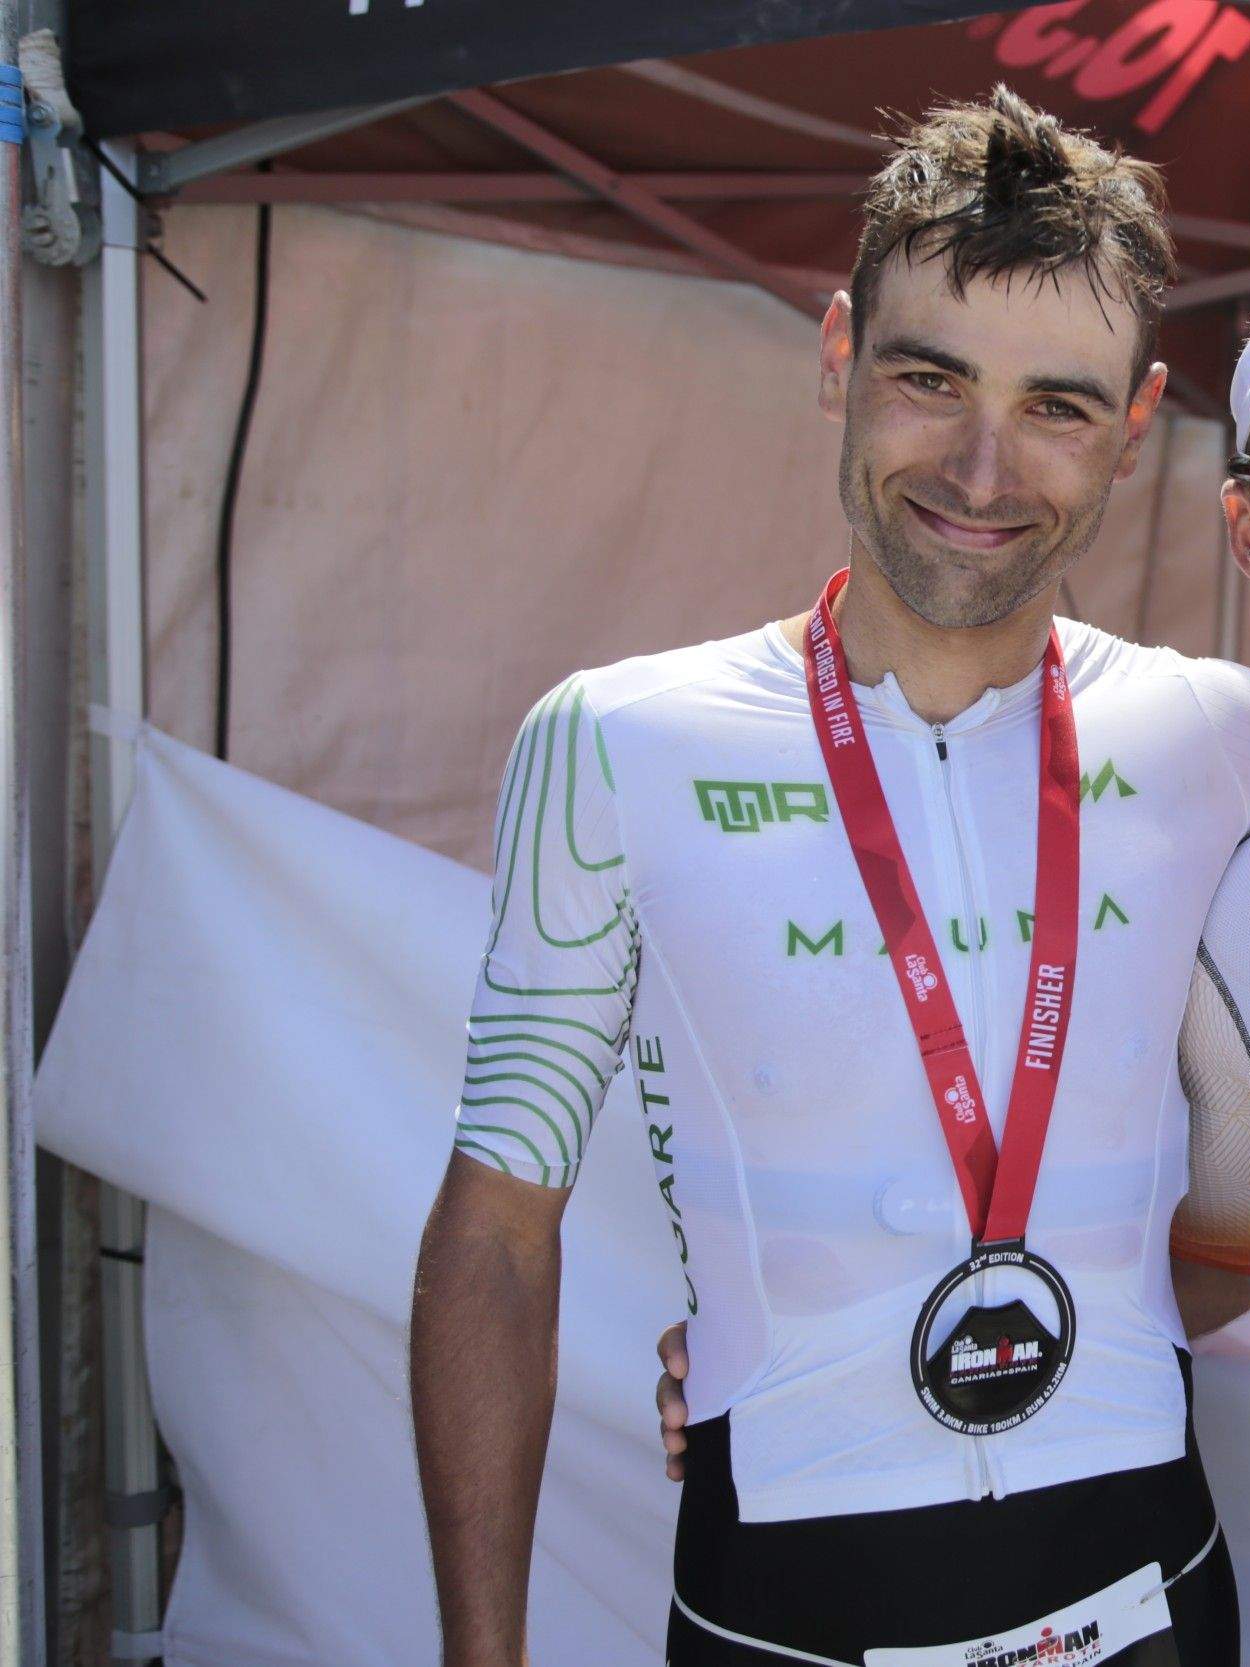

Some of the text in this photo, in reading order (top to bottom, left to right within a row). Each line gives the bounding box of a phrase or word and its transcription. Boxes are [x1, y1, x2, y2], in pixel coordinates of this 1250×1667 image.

[813, 639, 838, 693] FORGED
[822, 691, 845, 713] IN
[828, 712, 855, 748] FIRE
[1025, 963, 1065, 1070] FINISHER
[988, 1251, 1025, 1264] EDITION
[920, 1386, 939, 1414] SWIM
[968, 1423, 989, 1434] BIKE
[991, 1415, 1021, 1432] 180KM
[1026, 1397, 1045, 1416] RUN
